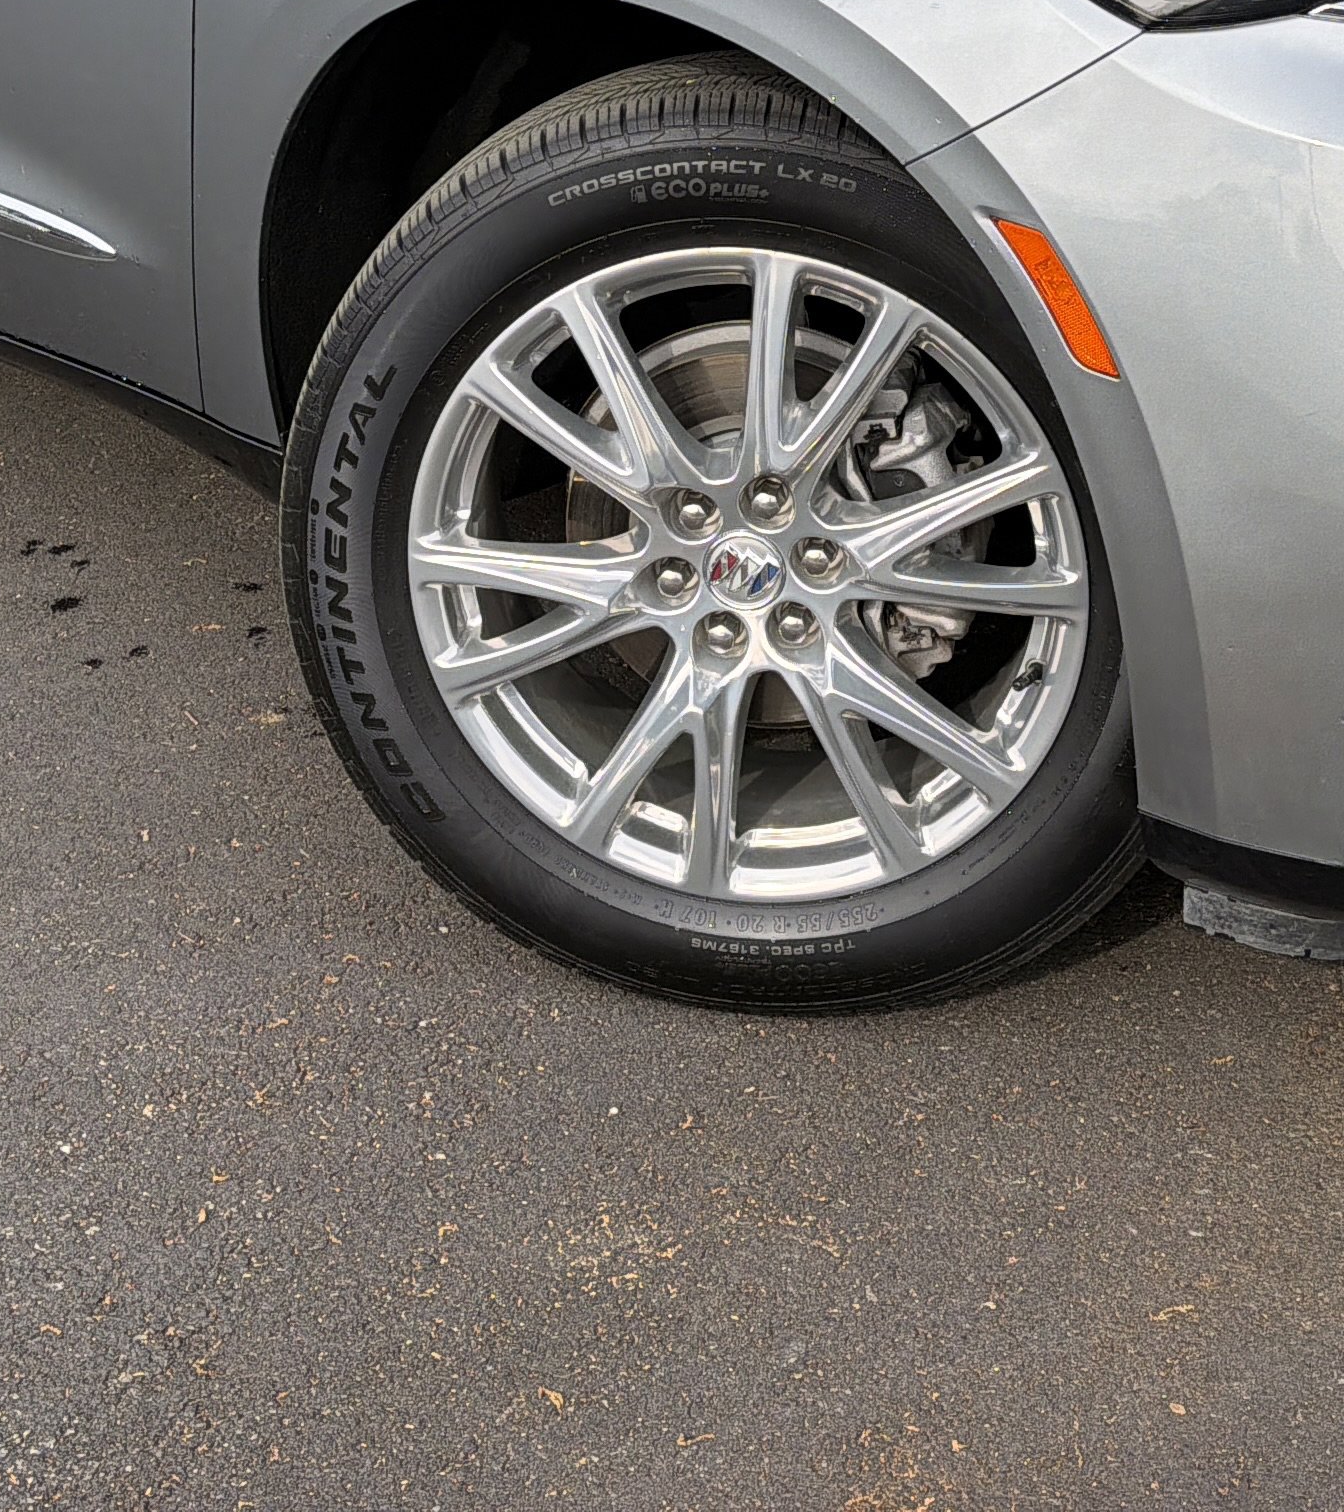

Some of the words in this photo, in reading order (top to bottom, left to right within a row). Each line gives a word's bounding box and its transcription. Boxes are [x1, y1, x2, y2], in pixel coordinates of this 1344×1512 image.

[547, 159, 767, 207] CROSSCONTACT
[777, 164, 816, 183] LX
[819, 174, 858, 194] 20
[325, 364, 446, 822] CONTINENTAL
[659, 899, 674, 918] H
[678, 907, 717, 929] 107
[796, 903, 879, 933] 255/55
[736, 913, 764, 934] 20
[765, 944, 815, 957] SPEC.
[821, 938, 856, 953] TPC
